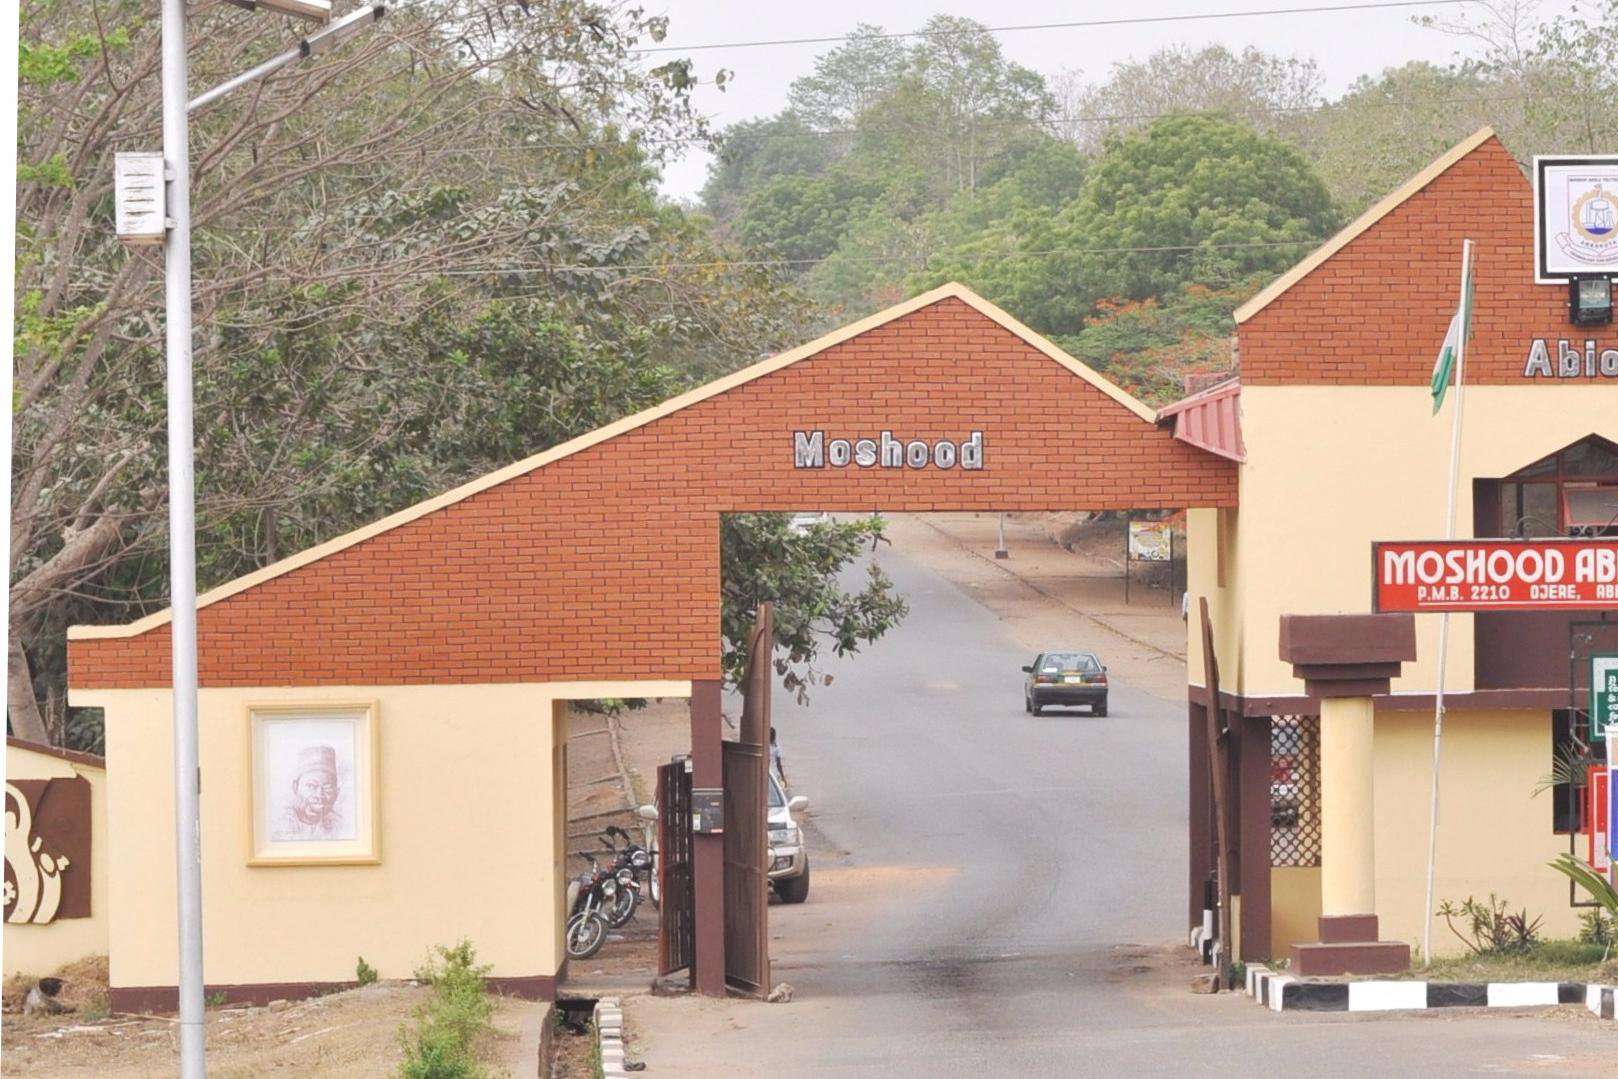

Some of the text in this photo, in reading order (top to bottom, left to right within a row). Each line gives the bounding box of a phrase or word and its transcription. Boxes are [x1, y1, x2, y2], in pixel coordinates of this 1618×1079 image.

[793, 430, 984, 470] Moshood
[1384, 549, 1565, 584] MOSHOOD
[1417, 585, 1464, 601] P.M.B.
[1471, 585, 1510, 600] 2210
